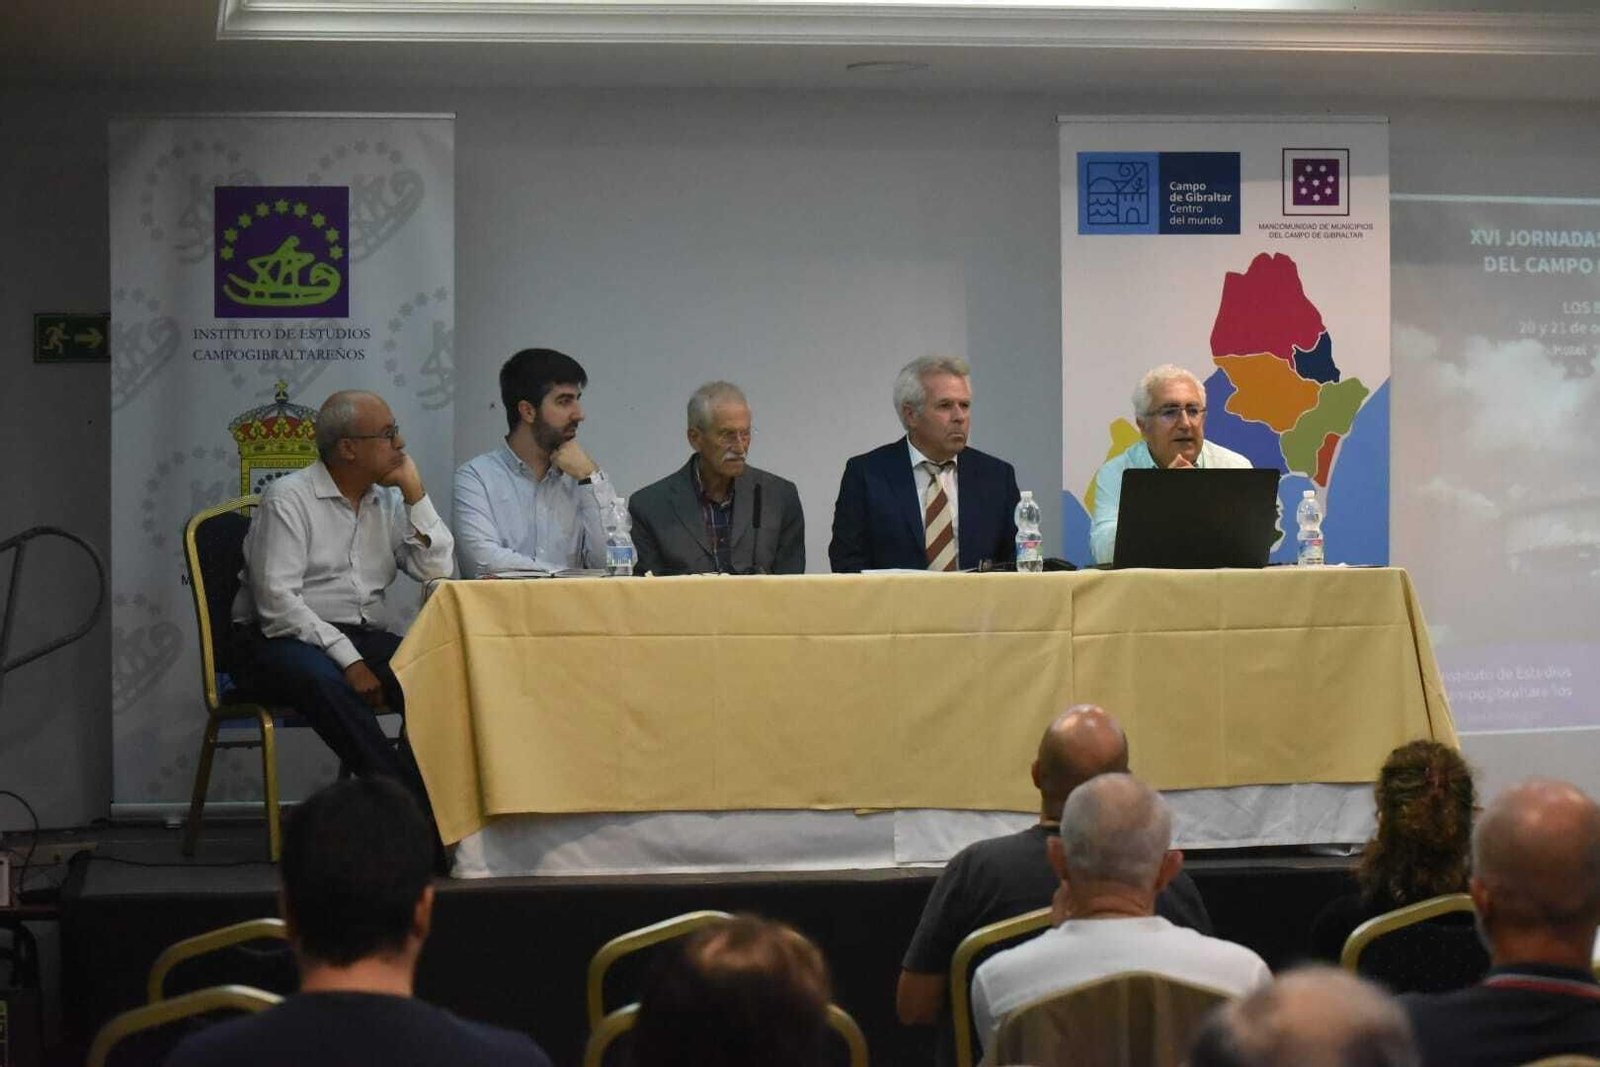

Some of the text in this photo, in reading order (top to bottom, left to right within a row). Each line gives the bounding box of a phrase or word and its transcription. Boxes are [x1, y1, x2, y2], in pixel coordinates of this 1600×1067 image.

[1170, 182, 1206, 192] Campo
[1170, 193, 1232, 202] de Gibraltar
[1170, 204, 1203, 213] Centro
[1170, 215, 1223, 225] del mundo
[1269, 231, 1364, 239] DEL CAMPO DE GIBRALTAR
[1470, 229, 1500, 245] XVI
[1484, 256, 1521, 273] DEL
[1525, 257, 1594, 274] CAMPO
[1563, 301, 1591, 314] LOS
[193, 328, 371, 340] INSTITUTO DE ESTUDIOS
[1540, 323, 1548, 338] y
[1569, 321, 1588, 334] de
[193, 347, 365, 361] CAMPOGIBRALTAREÑOS
